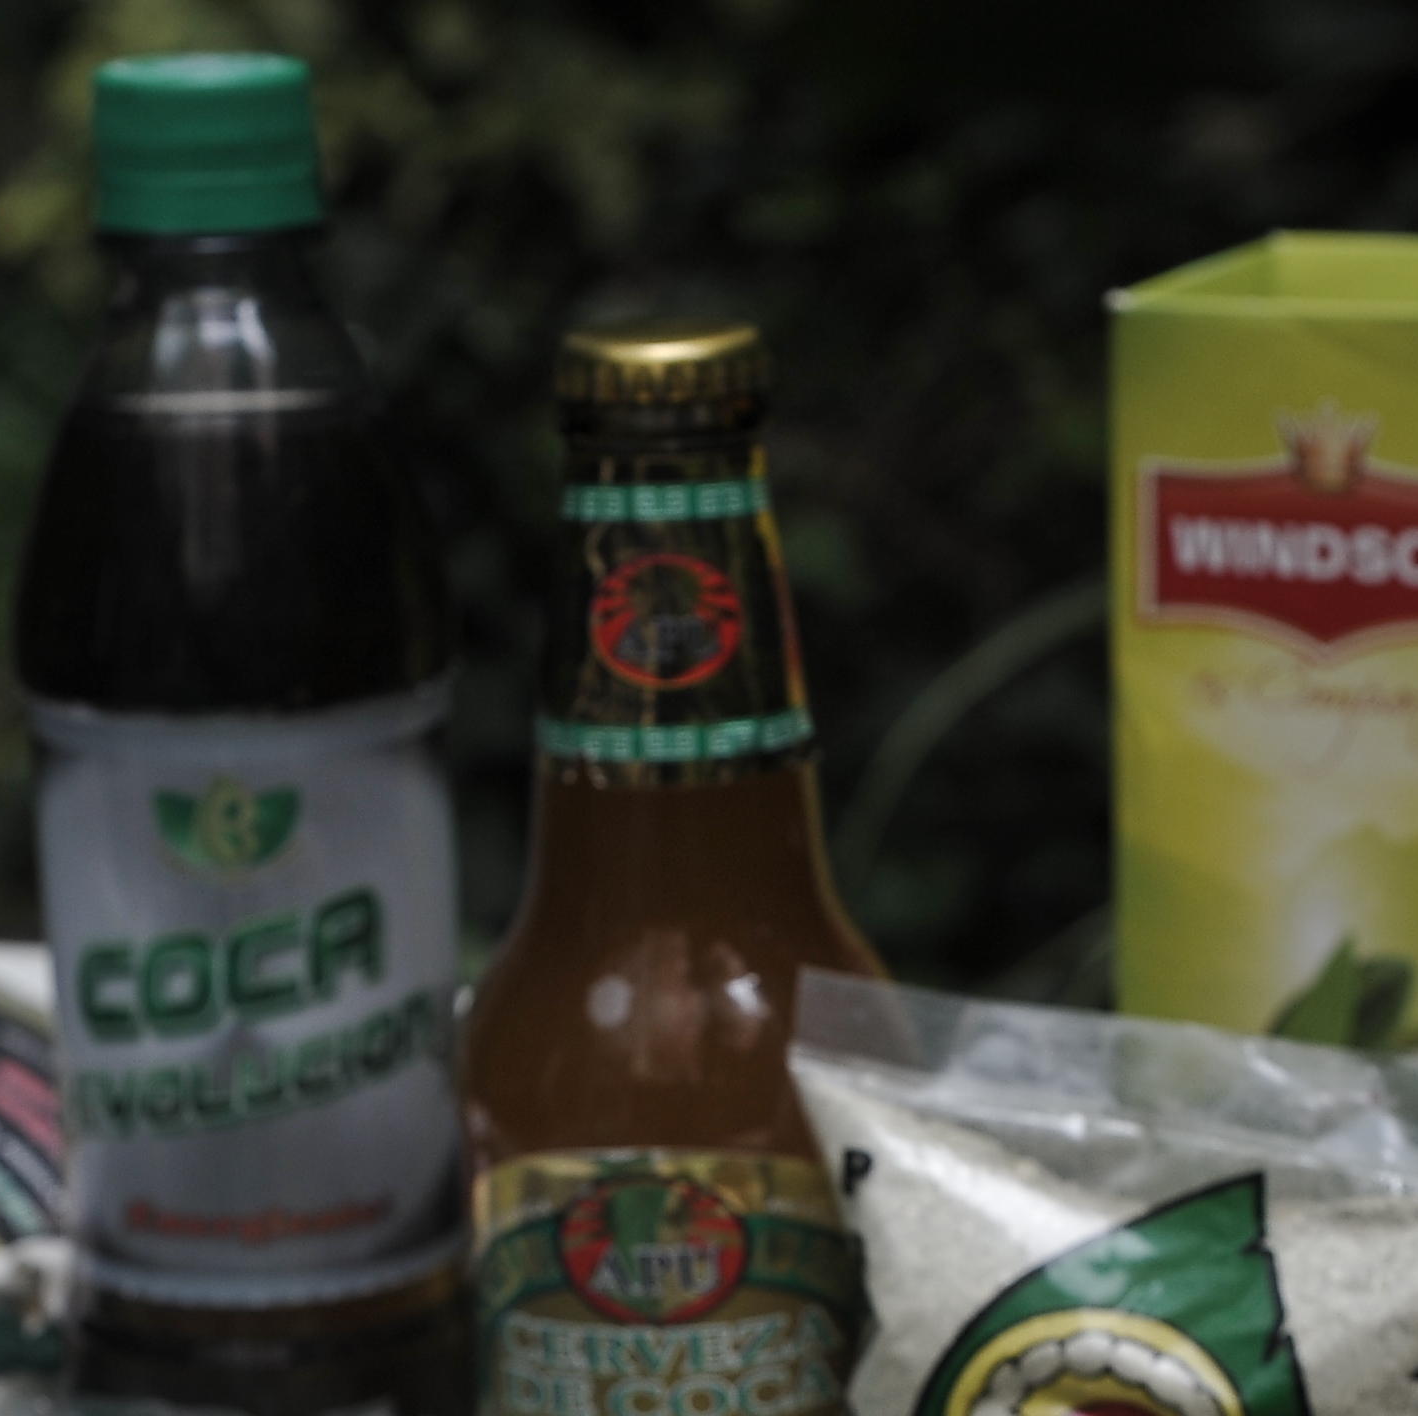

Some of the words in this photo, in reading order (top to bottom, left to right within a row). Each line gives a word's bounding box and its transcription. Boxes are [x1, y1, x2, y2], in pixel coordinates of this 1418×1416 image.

[78, 886, 386, 1042] COCA
[589, 1242, 721, 1296] APU
[501, 1305, 841, 1375] CERVEZA
